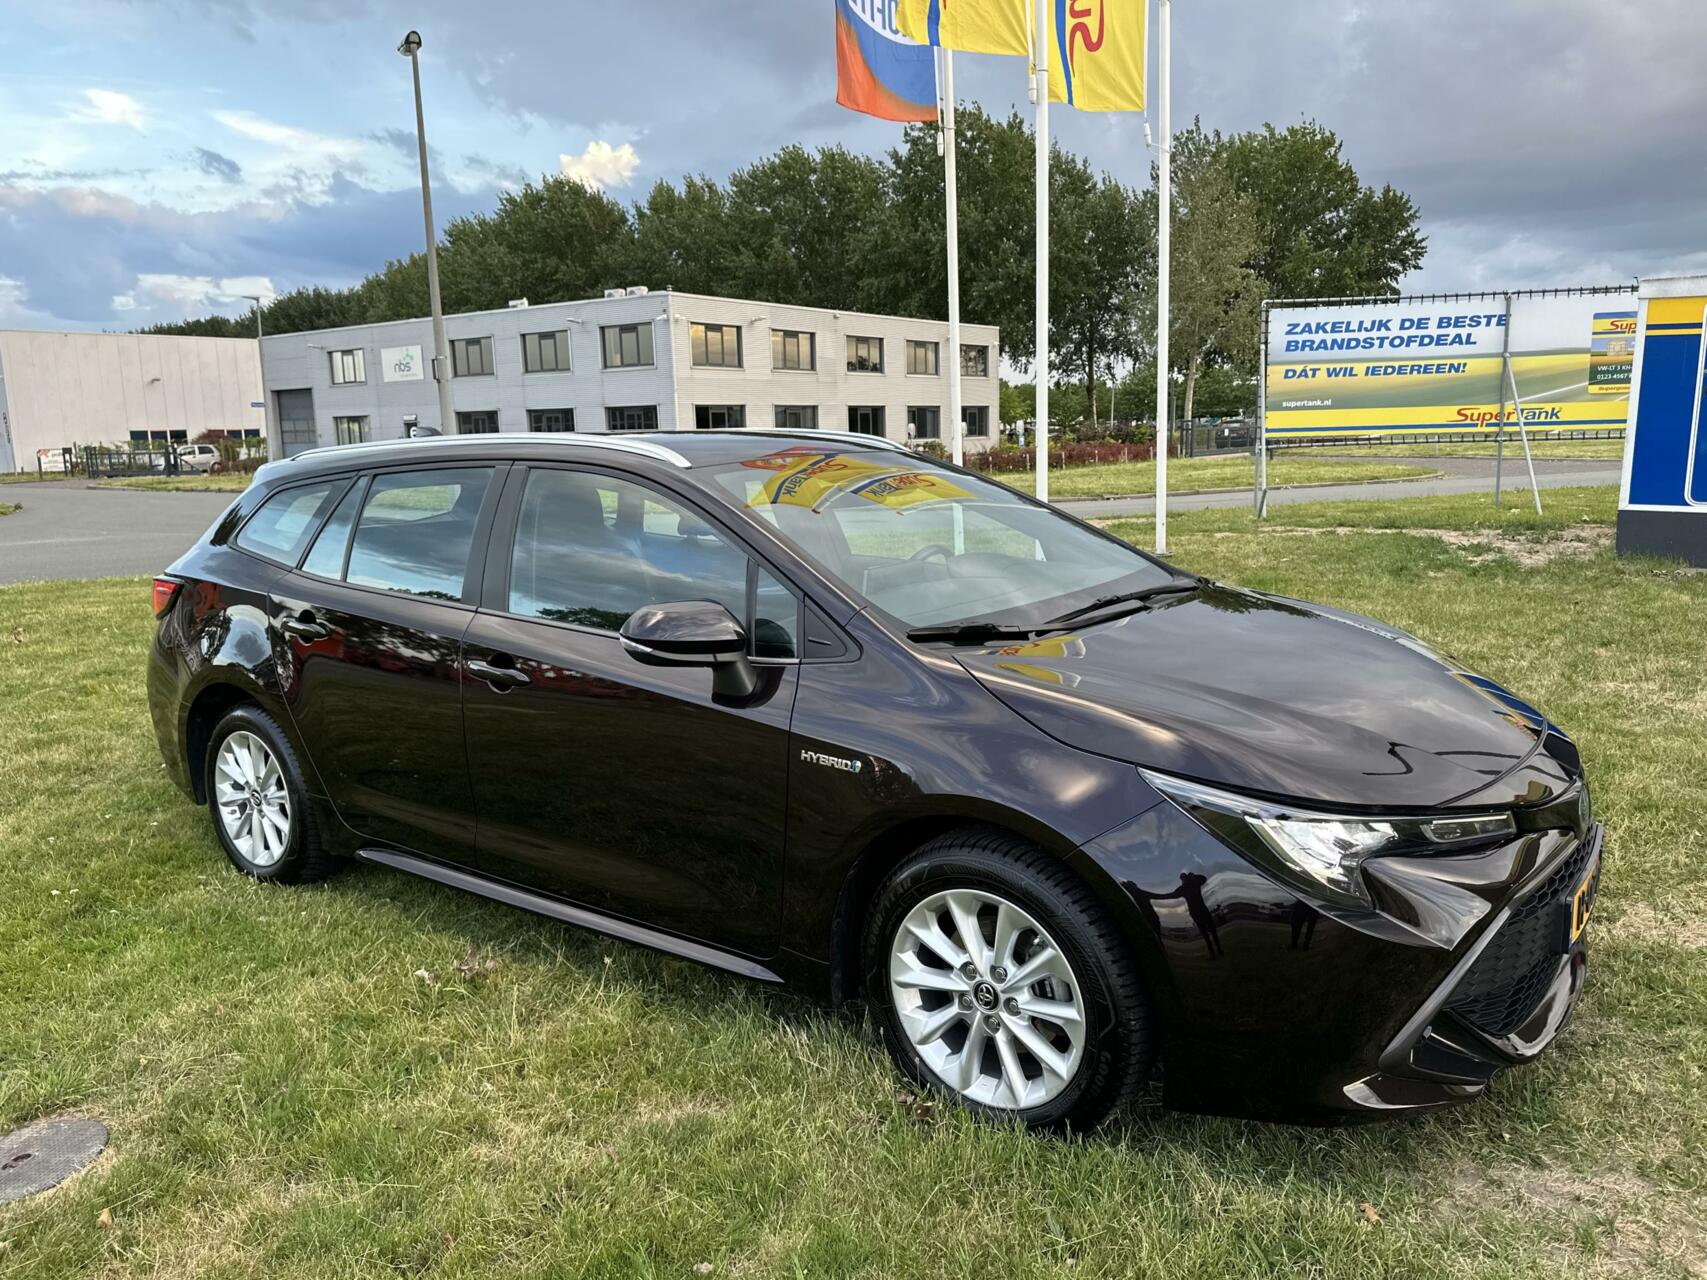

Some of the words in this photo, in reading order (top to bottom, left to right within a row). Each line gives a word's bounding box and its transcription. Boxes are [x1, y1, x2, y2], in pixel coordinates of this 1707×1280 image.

[1285, 319, 1393, 335] ZAKELIJK
[1399, 317, 1430, 331] DE
[1437, 314, 1511, 329] BESTE
[1285, 333, 1477, 352] BRANDSTOFDEAL
[393, 359, 412, 373] nbs
[1284, 365, 1320, 379] DÁT
[1326, 366, 1358, 378] WIL
[1364, 362, 1467, 377] IEDEREEN!
[1282, 399, 1332, 408] supertank.nl
[1446, 407, 1561, 428] SuperTank
[800, 749, 852, 771] HYBRID
